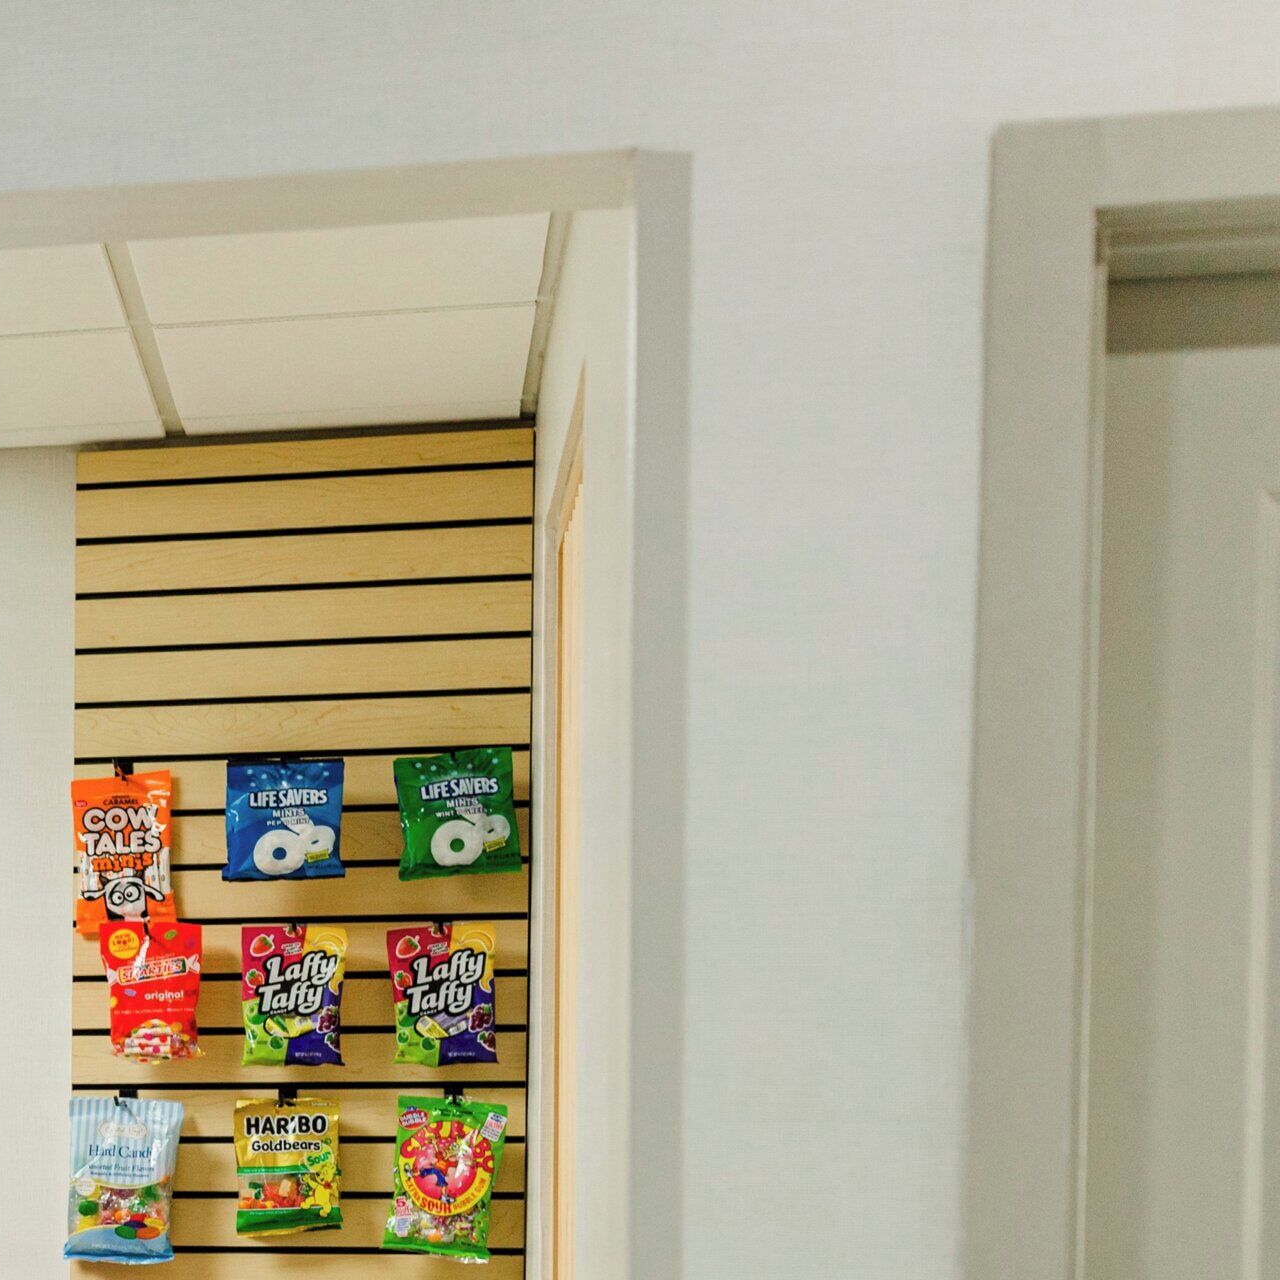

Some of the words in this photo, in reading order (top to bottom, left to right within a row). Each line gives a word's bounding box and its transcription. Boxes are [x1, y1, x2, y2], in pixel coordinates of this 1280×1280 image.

[249, 790, 278, 808] LIFE
[278, 788, 328, 808] SAVERS
[421, 781, 451, 800] LIFE
[451, 777, 498, 796] SAVERS
[446, 797, 479, 808] MINTS
[83, 806, 158, 832] COW
[272, 808, 305, 818] MINTS
[82, 830, 163, 857] TALES
[265, 951, 338, 986] Laffy
[412, 949, 486, 985] Laffy
[144, 989, 184, 1002] original
[258, 980, 324, 1014] Taffy
[406, 980, 473, 1014] Taffy
[88, 1144, 116, 1157] Hard
[251, 1140, 321, 1152] Goldbears
[306, 1150, 331, 1166] Sour
[419, 1196, 452, 1214] SOUR
